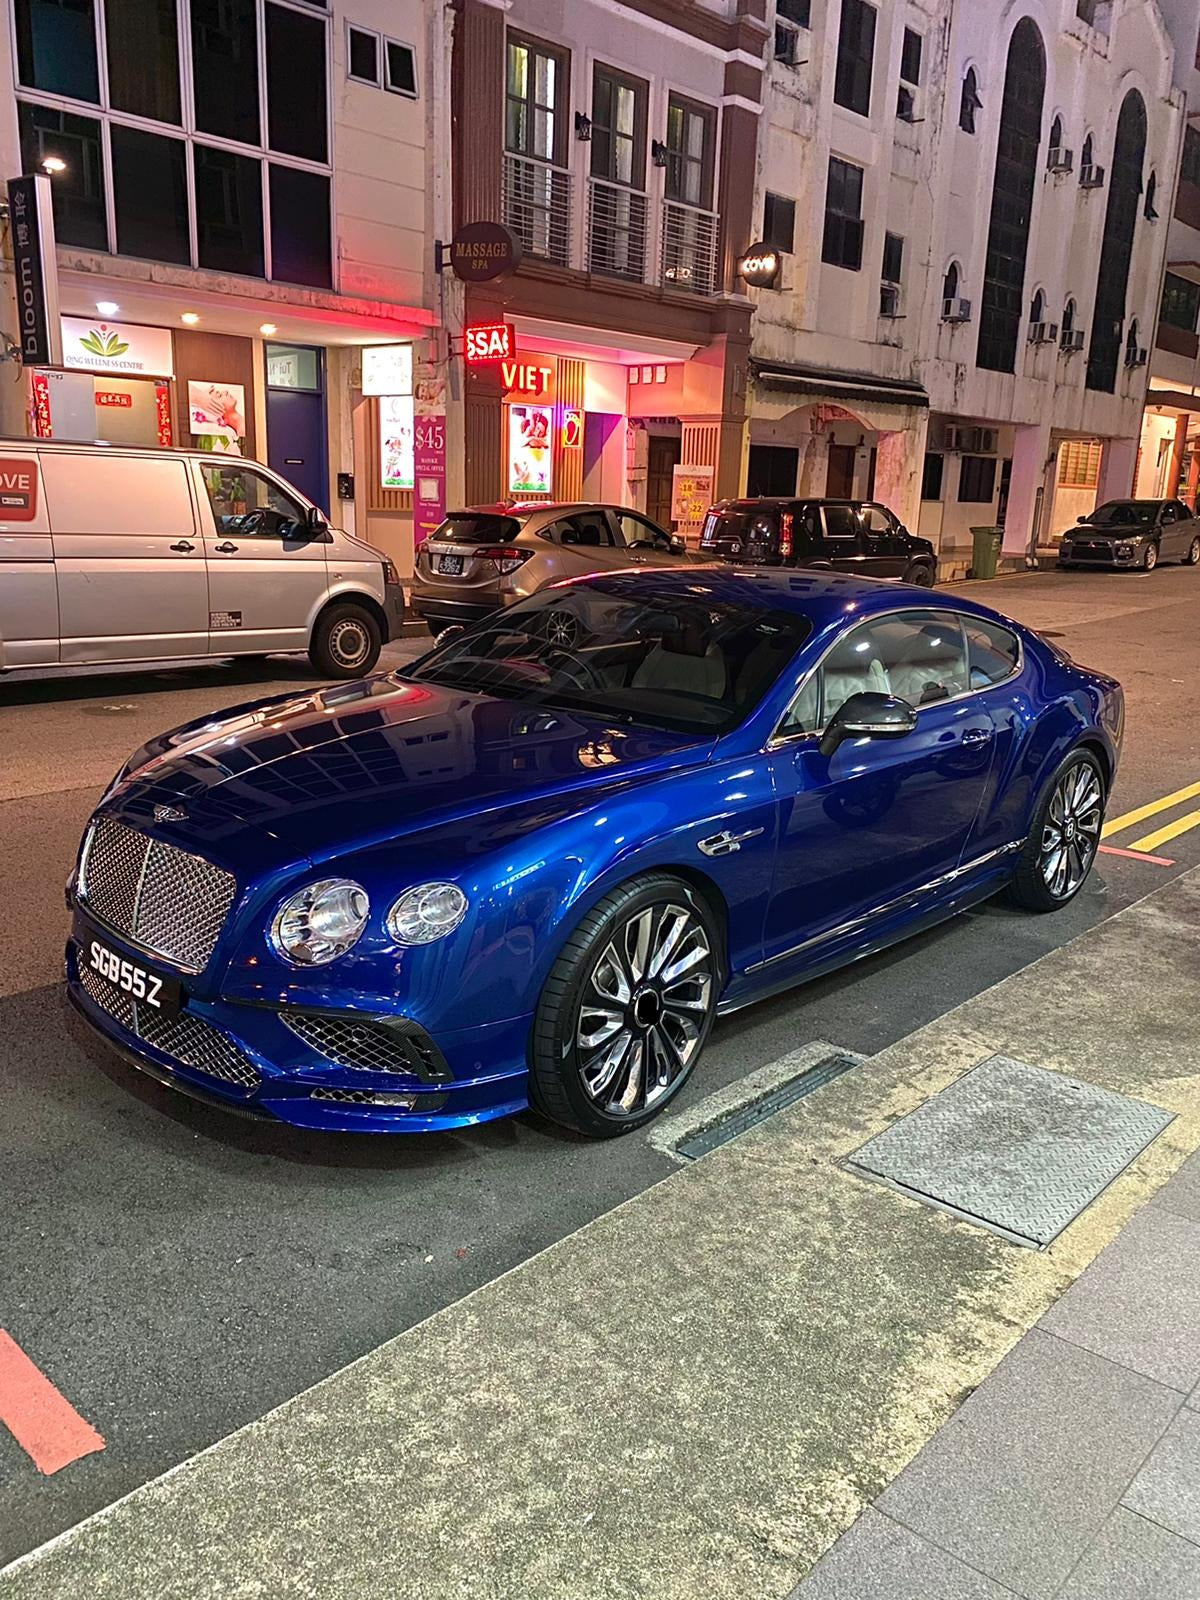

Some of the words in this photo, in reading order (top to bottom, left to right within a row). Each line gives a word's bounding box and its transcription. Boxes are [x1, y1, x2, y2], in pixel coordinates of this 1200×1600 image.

[455, 242, 508, 257] MASSAGE
[471, 259, 489, 270] SPA
[20, 257, 38, 355] bloom
[84, 357, 118, 368] WELLNESS
[119, 361, 144, 370] CENTRE
[501, 362, 552, 393] VIET
[415, 425, 444, 450] $45
[0, 472, 30, 490] VE
[90, 941, 163, 1008] SGB55Z
